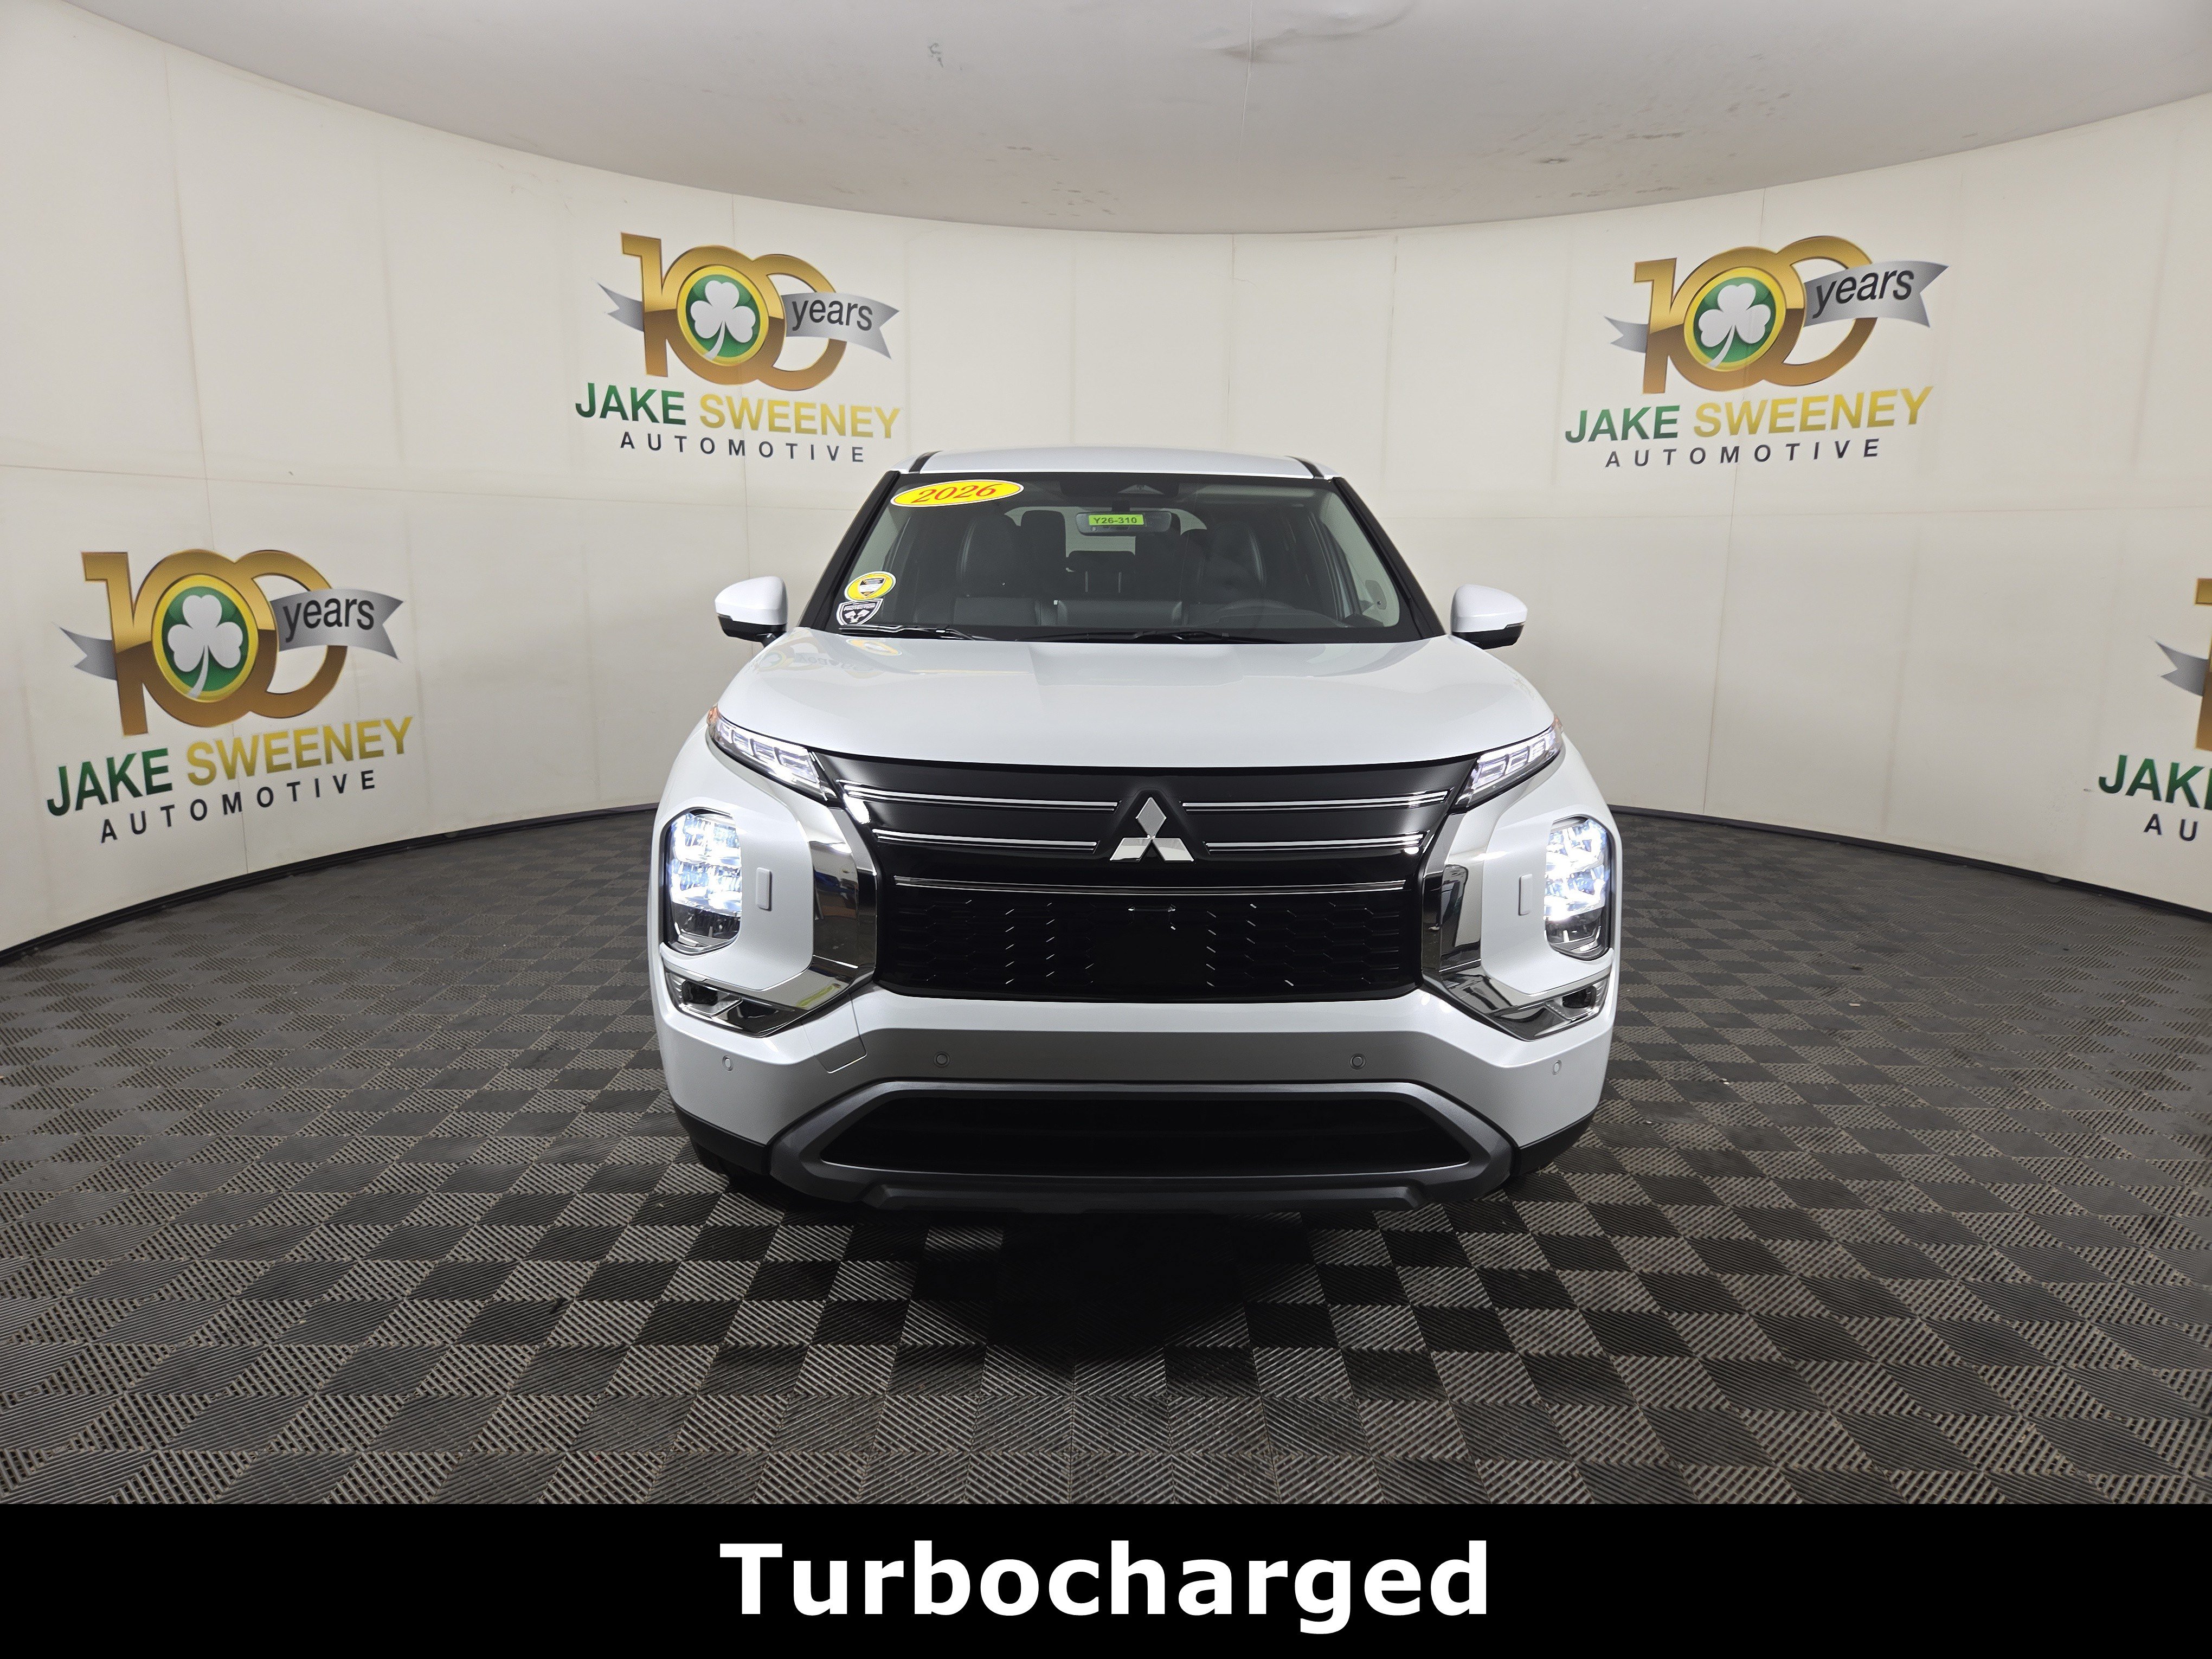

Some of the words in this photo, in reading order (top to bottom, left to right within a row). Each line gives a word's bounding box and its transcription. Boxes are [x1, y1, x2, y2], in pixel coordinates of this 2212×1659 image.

[621, 232, 847, 391] 100
[792, 299, 873, 331] years
[1633, 235, 1878, 394] 100
[1812, 270, 1915, 319] years
[575, 382, 686, 426] JAKE
[699, 393, 901, 439] SWEENEY
[1565, 404, 1680, 443] JAKE
[1693, 386, 1934, 438] SWEENEY
[620, 431, 864, 462] AUTOMOTIVE
[1605, 438, 1880, 468] AUTOMOTIVE
[910, 483, 1003, 504] 2026
[80, 548, 348, 737] 100
[282, 597, 375, 644] years
[47, 747, 173, 816] JAKE
[186, 716, 413, 786] SWEENEY
[100, 769, 375, 844] AUTOMOTIVE
